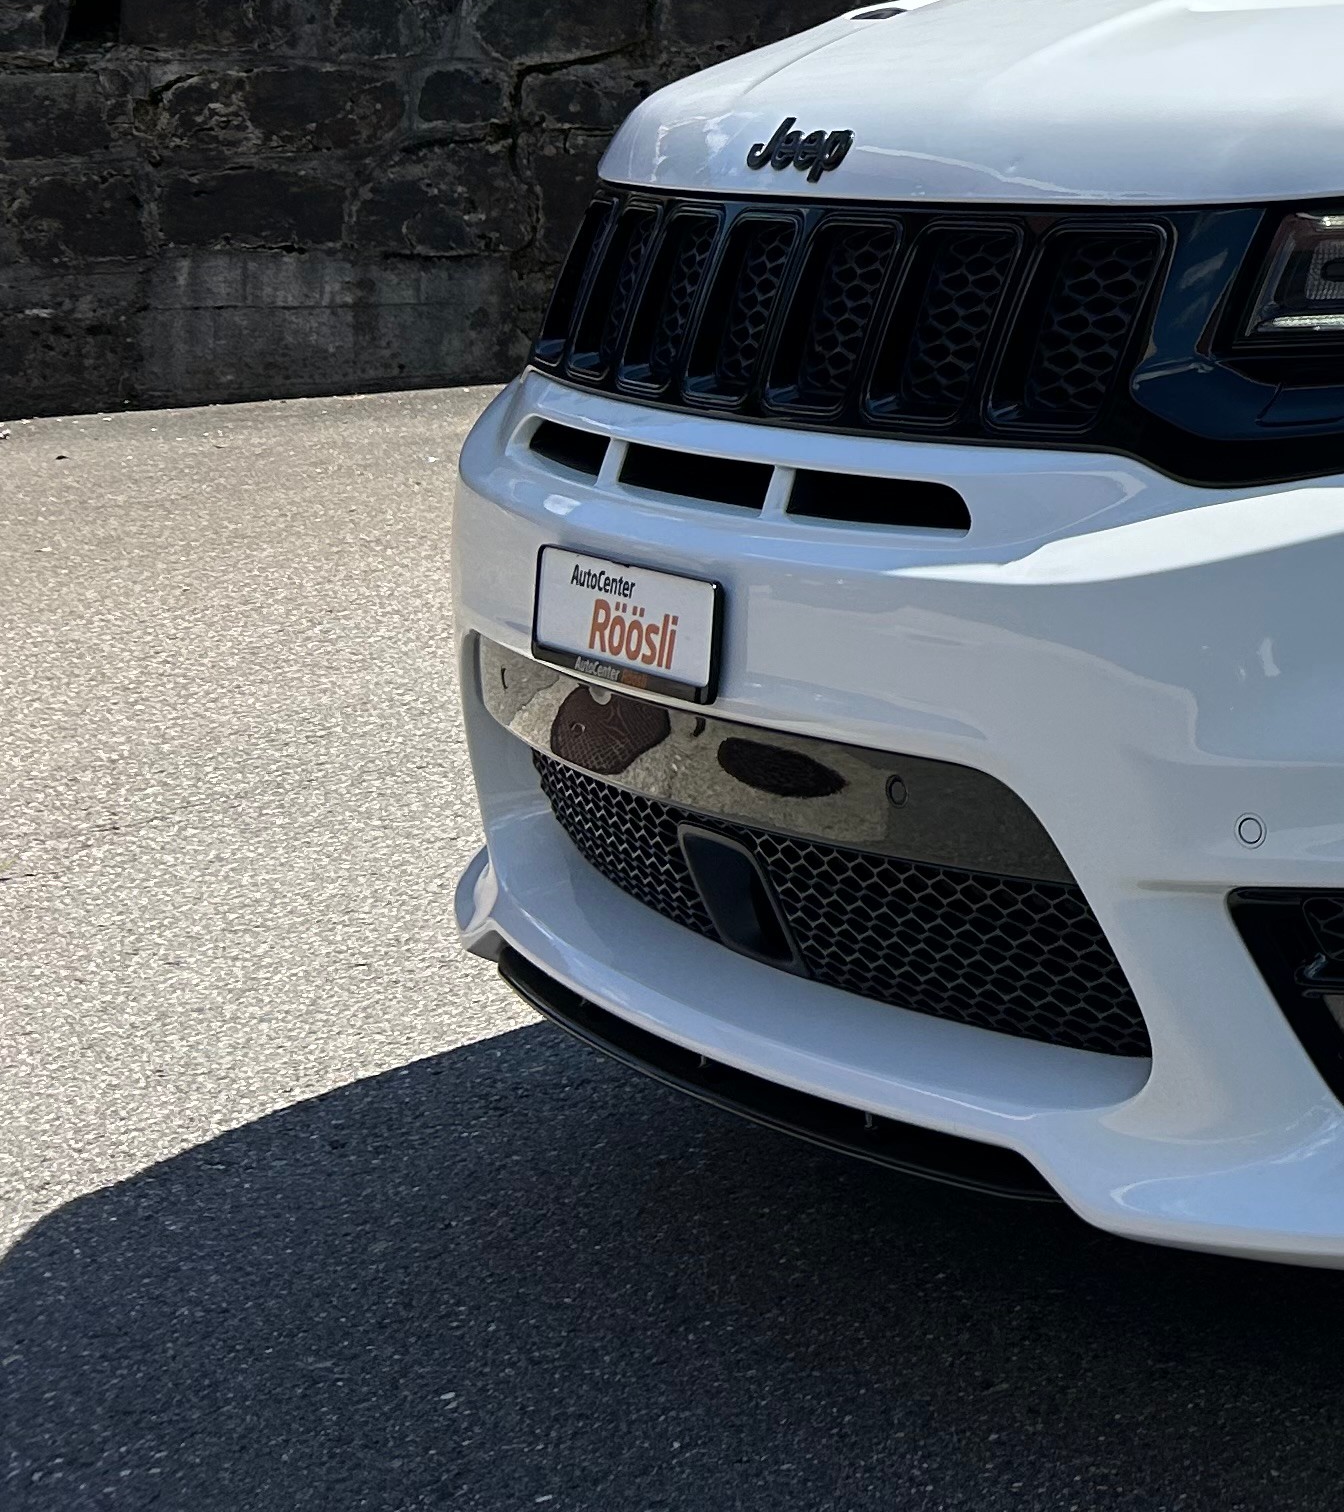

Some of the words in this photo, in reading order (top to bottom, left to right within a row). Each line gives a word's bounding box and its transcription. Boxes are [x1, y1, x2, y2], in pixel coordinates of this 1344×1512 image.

[747, 116, 855, 183] Jeep
[570, 564, 636, 599] AutoCenter
[588, 598, 680, 670] Röösli
[574, 656, 620, 682] AutoCenter
